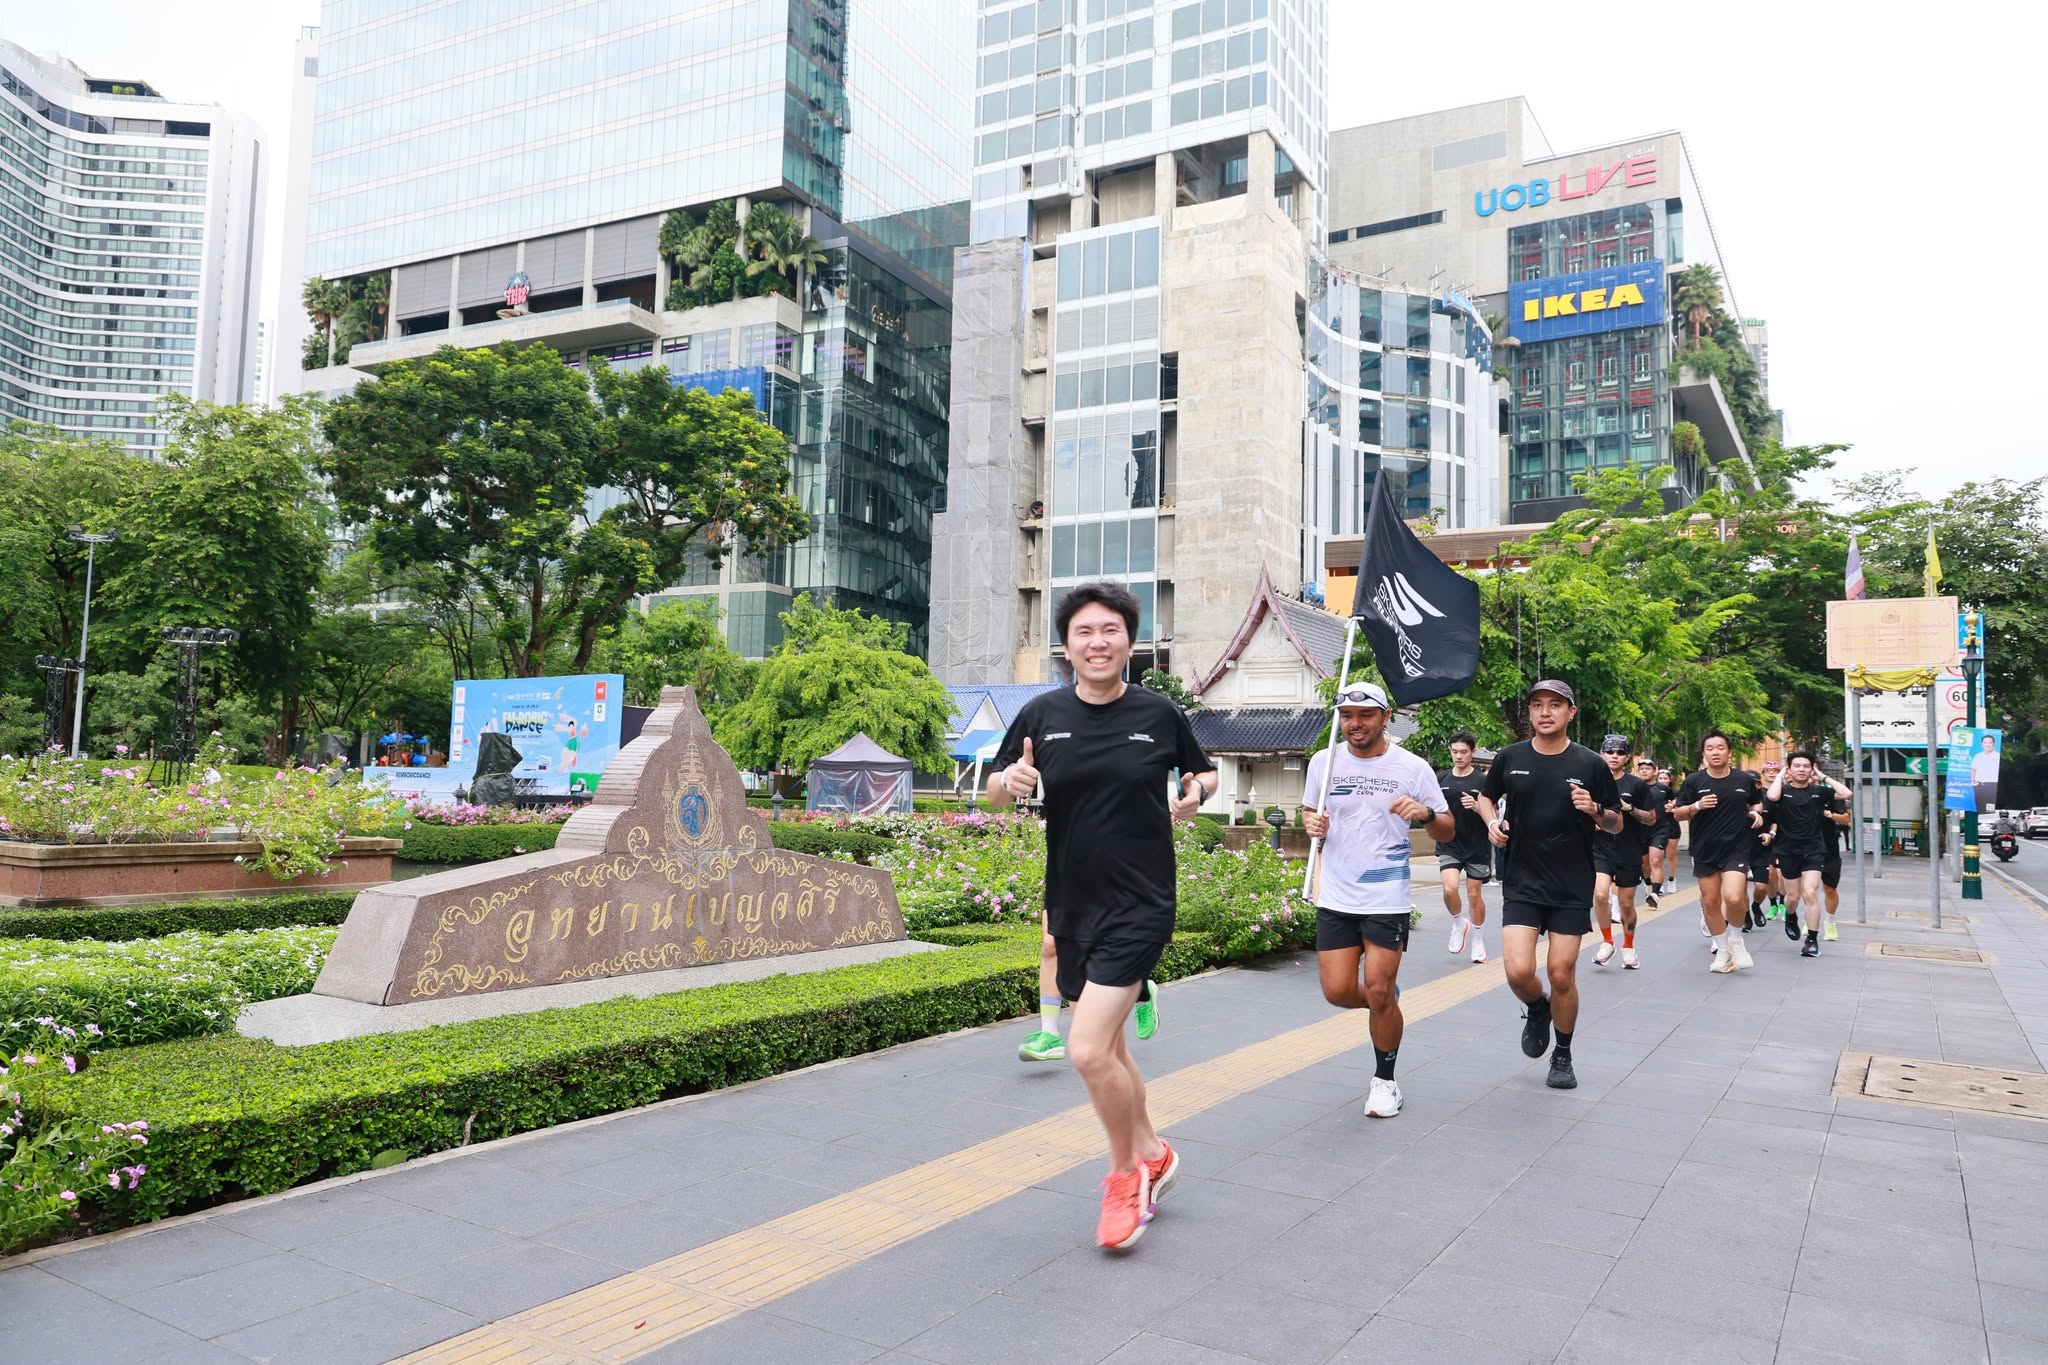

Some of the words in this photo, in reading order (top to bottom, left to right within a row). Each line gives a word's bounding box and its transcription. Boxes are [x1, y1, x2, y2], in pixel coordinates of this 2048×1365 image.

[1475, 178, 1550, 217] UOB
[1559, 154, 1657, 201] LIVE
[1524, 283, 1645, 322] IKEA
[505, 721, 544, 734] DANCE
[1957, 733, 1968, 745] 5
[1332, 776, 1399, 789] SKECHERS
[1358, 784, 1394, 794] RUNNING
